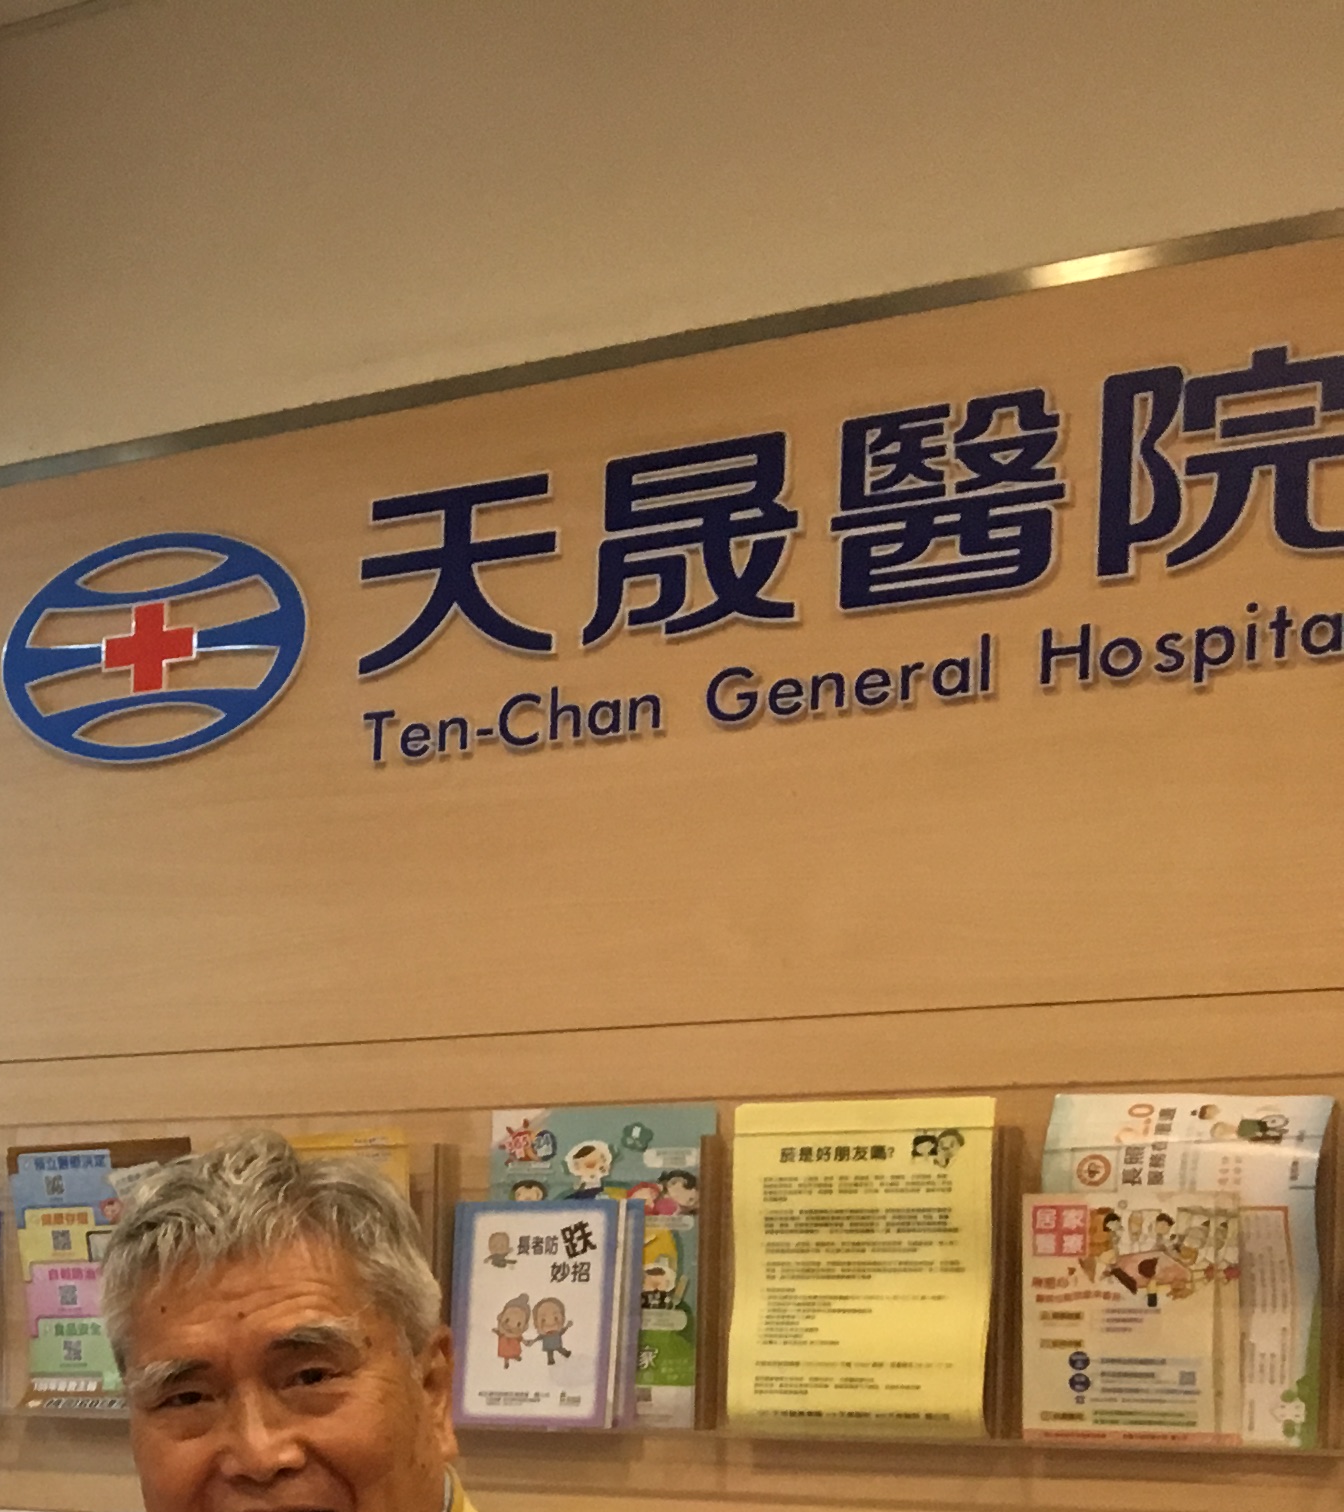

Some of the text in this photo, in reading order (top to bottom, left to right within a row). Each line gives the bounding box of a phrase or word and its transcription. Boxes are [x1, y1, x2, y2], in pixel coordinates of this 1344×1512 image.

[357, 342, 1344, 678] 天晟醫院
[363, 684, 664, 766] Ten-Chan
[703, 638, 994, 726] General
[550, 1261, 591, 1285] 妙招
